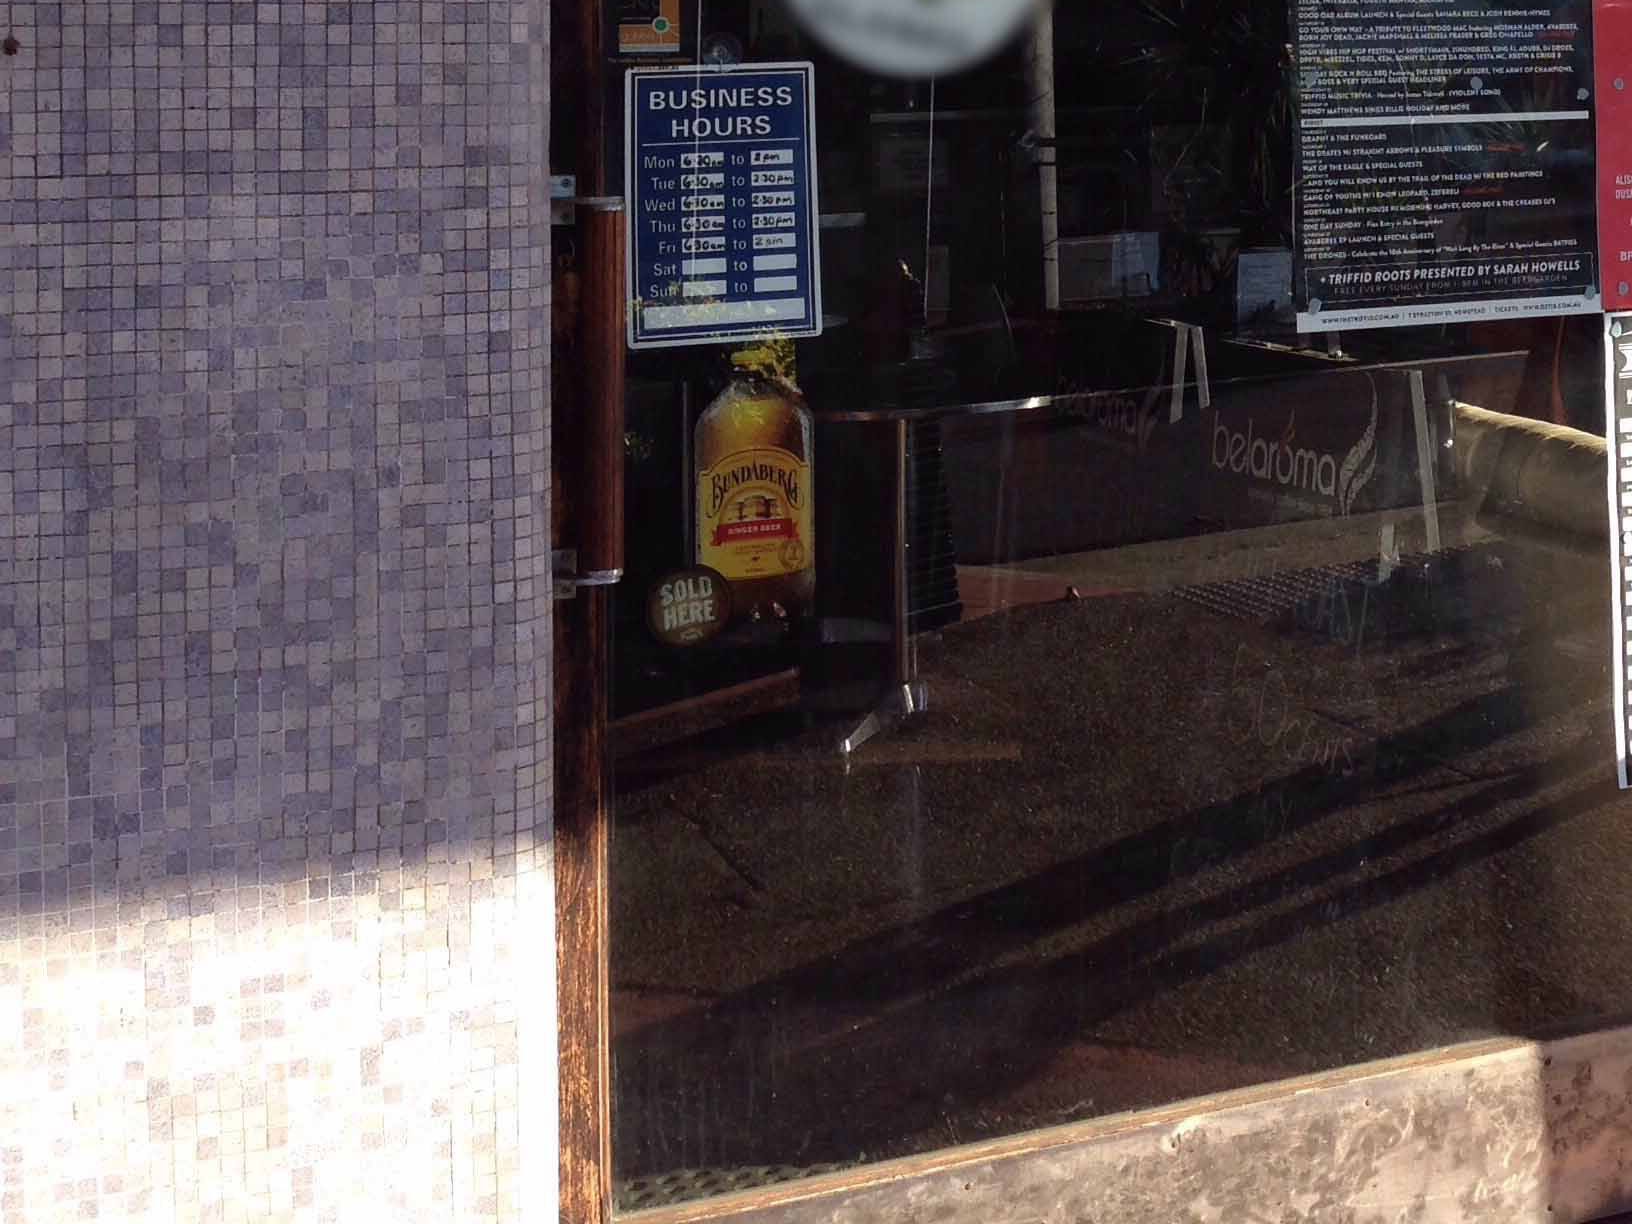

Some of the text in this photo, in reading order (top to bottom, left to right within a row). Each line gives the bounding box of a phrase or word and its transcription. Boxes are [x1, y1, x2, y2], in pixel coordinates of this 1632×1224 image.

[650, 87, 793, 110] BUSINESS
[671, 115, 772, 138] HOURS
[644, 156, 675, 169] Mon
[731, 155, 744, 165] to
[651, 178, 675, 190] Tue
[732, 176, 745, 187] to
[645, 199, 675, 212] Wed
[733, 197, 746, 208] to
[650, 220, 675, 233] Thu
[733, 218, 746, 229] to
[659, 241, 676, 253] Fri
[734, 239, 747, 250] to
[654, 261, 747, 276] Sat to
[1329, 260, 1580, 286] TRIFFID ROOTS PRESENTED BY SARAH HOWELLS
[650, 283, 747, 297] Sun to
[1211, 410, 1336, 496] belaroma
[709, 460, 801, 515] BUNDABERG
[659, 576, 713, 606] SOLD
[663, 600, 716, 631] HERE
